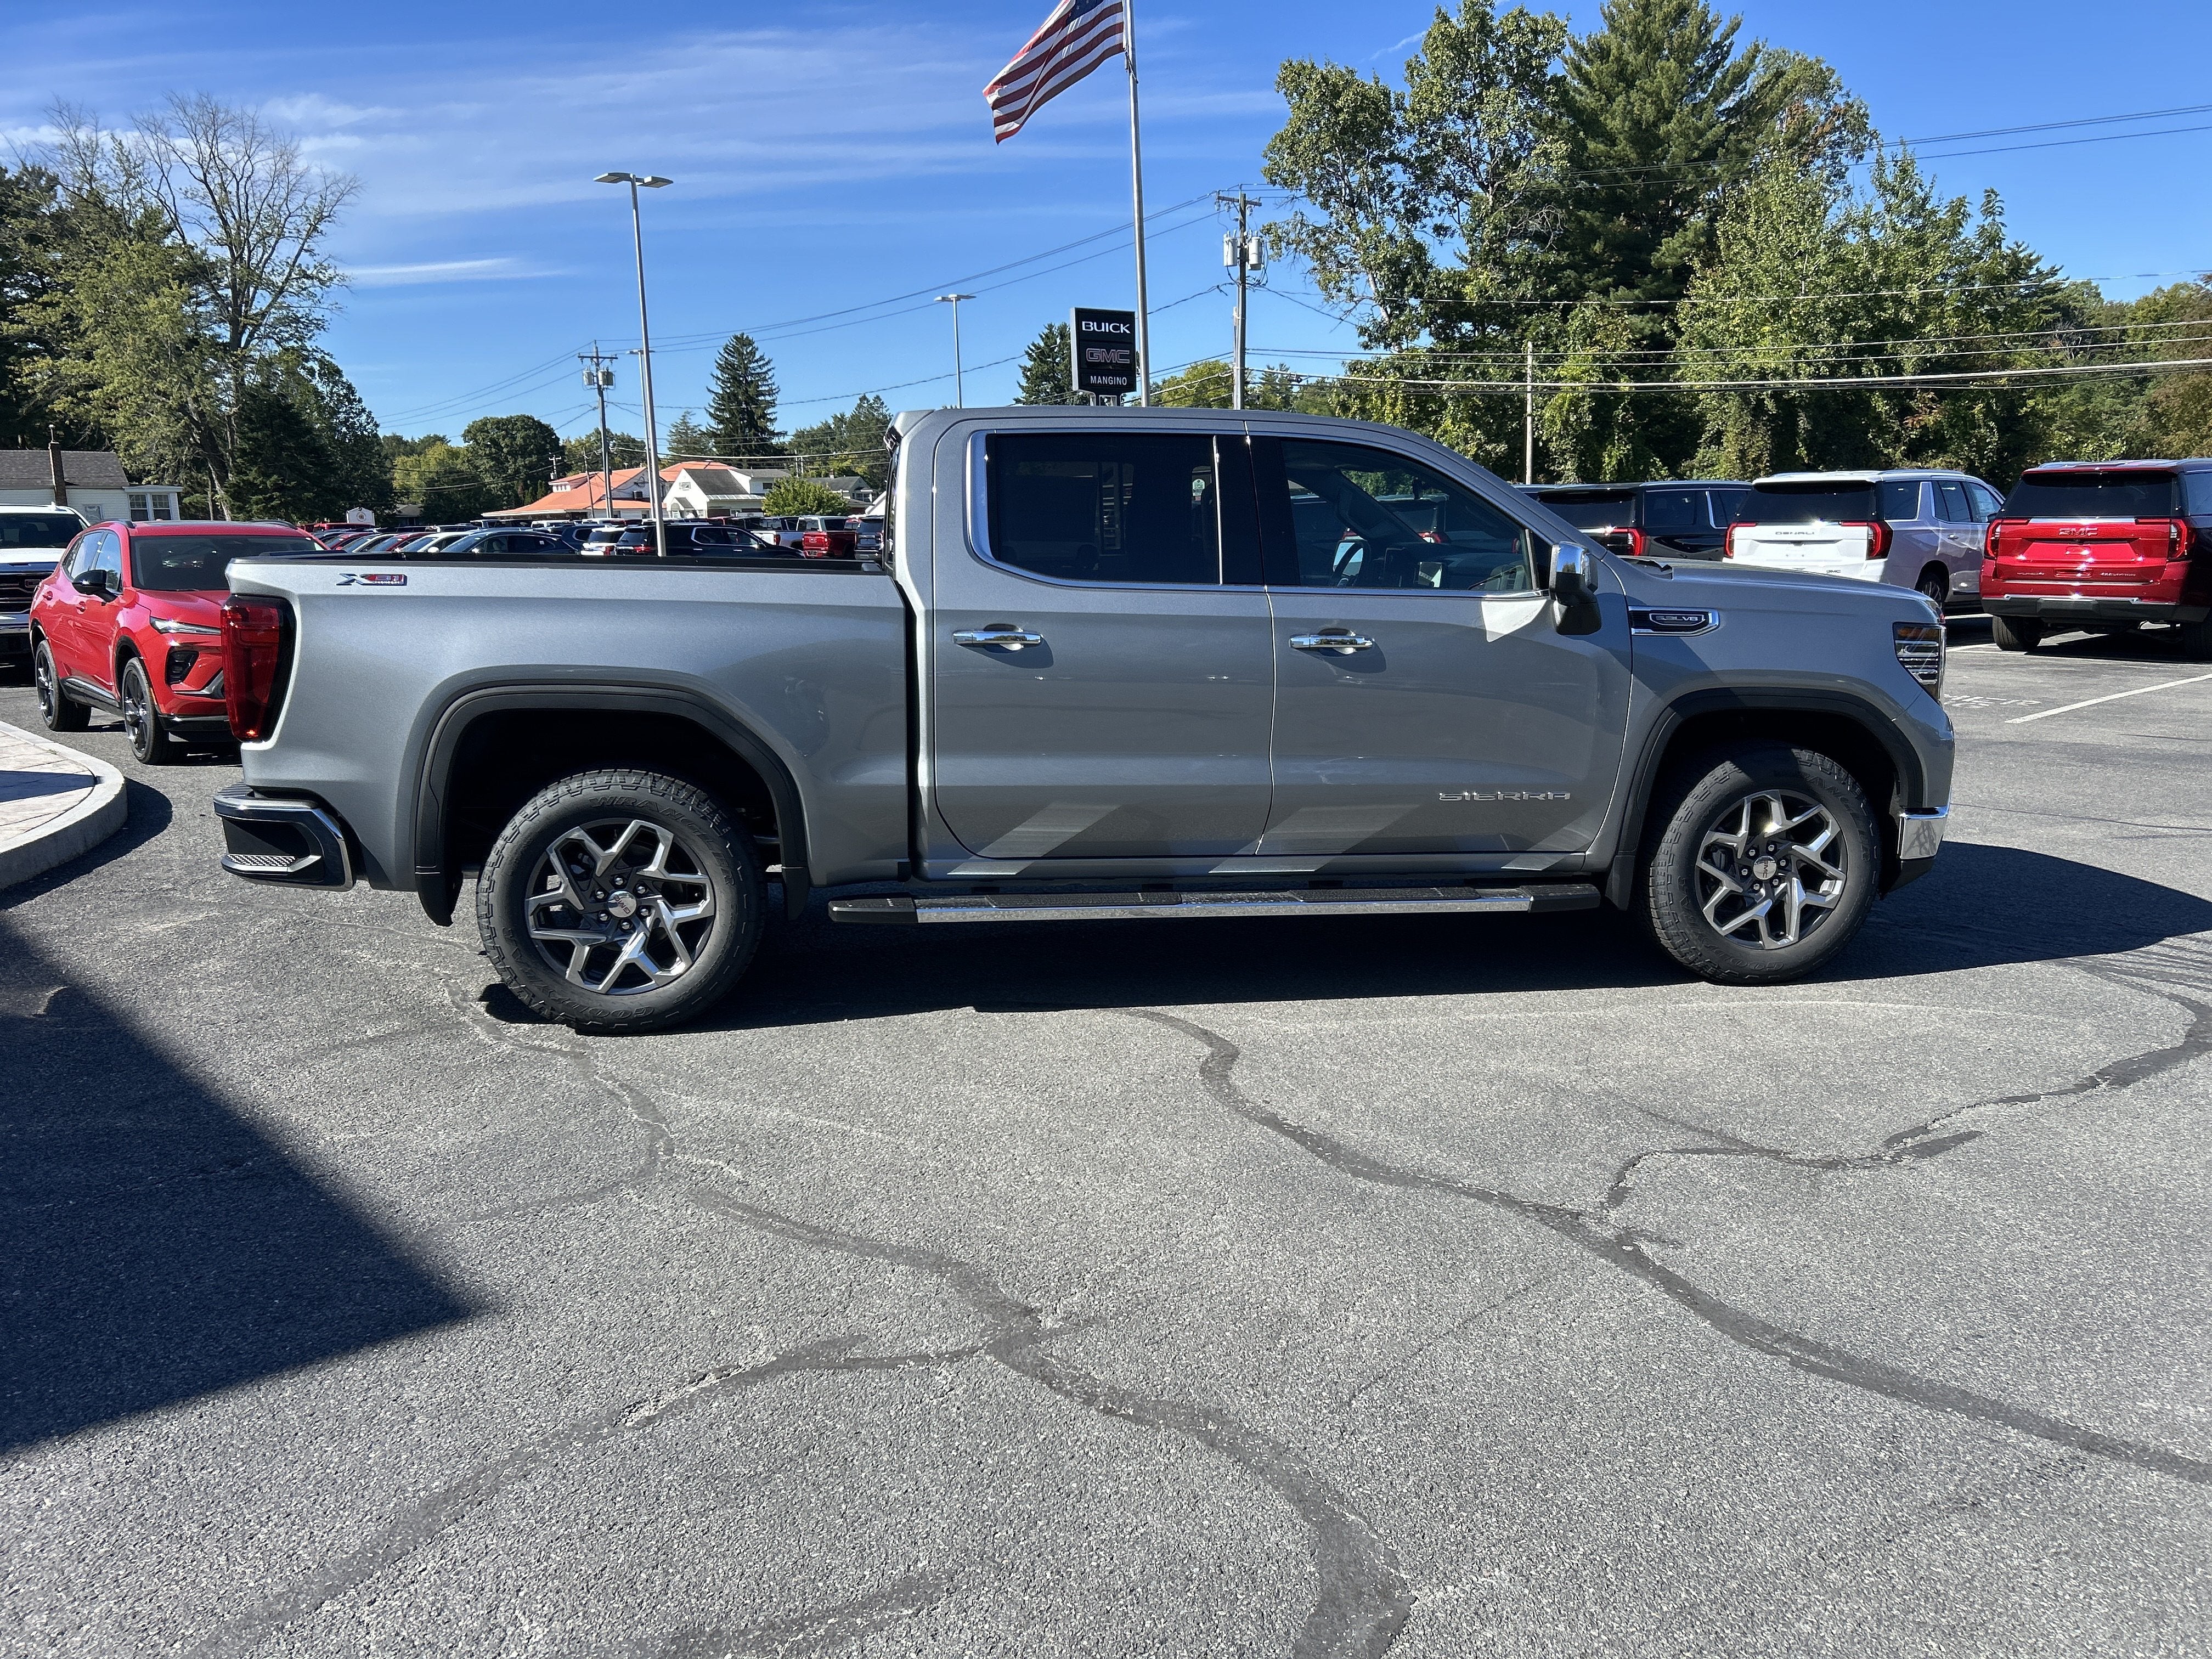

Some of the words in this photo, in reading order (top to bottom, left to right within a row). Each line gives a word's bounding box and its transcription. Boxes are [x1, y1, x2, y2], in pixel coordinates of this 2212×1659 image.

[1082, 321, 1131, 334] BUICK
[1086, 348, 1130, 364] GMC
[1090, 375, 1127, 386] MANGINO
[2059, 527, 2099, 536] GMC
[1439, 791, 1571, 802] SIERRA
[589, 795, 736, 885] WRANGLER
[614, 895, 631, 915] GMC
